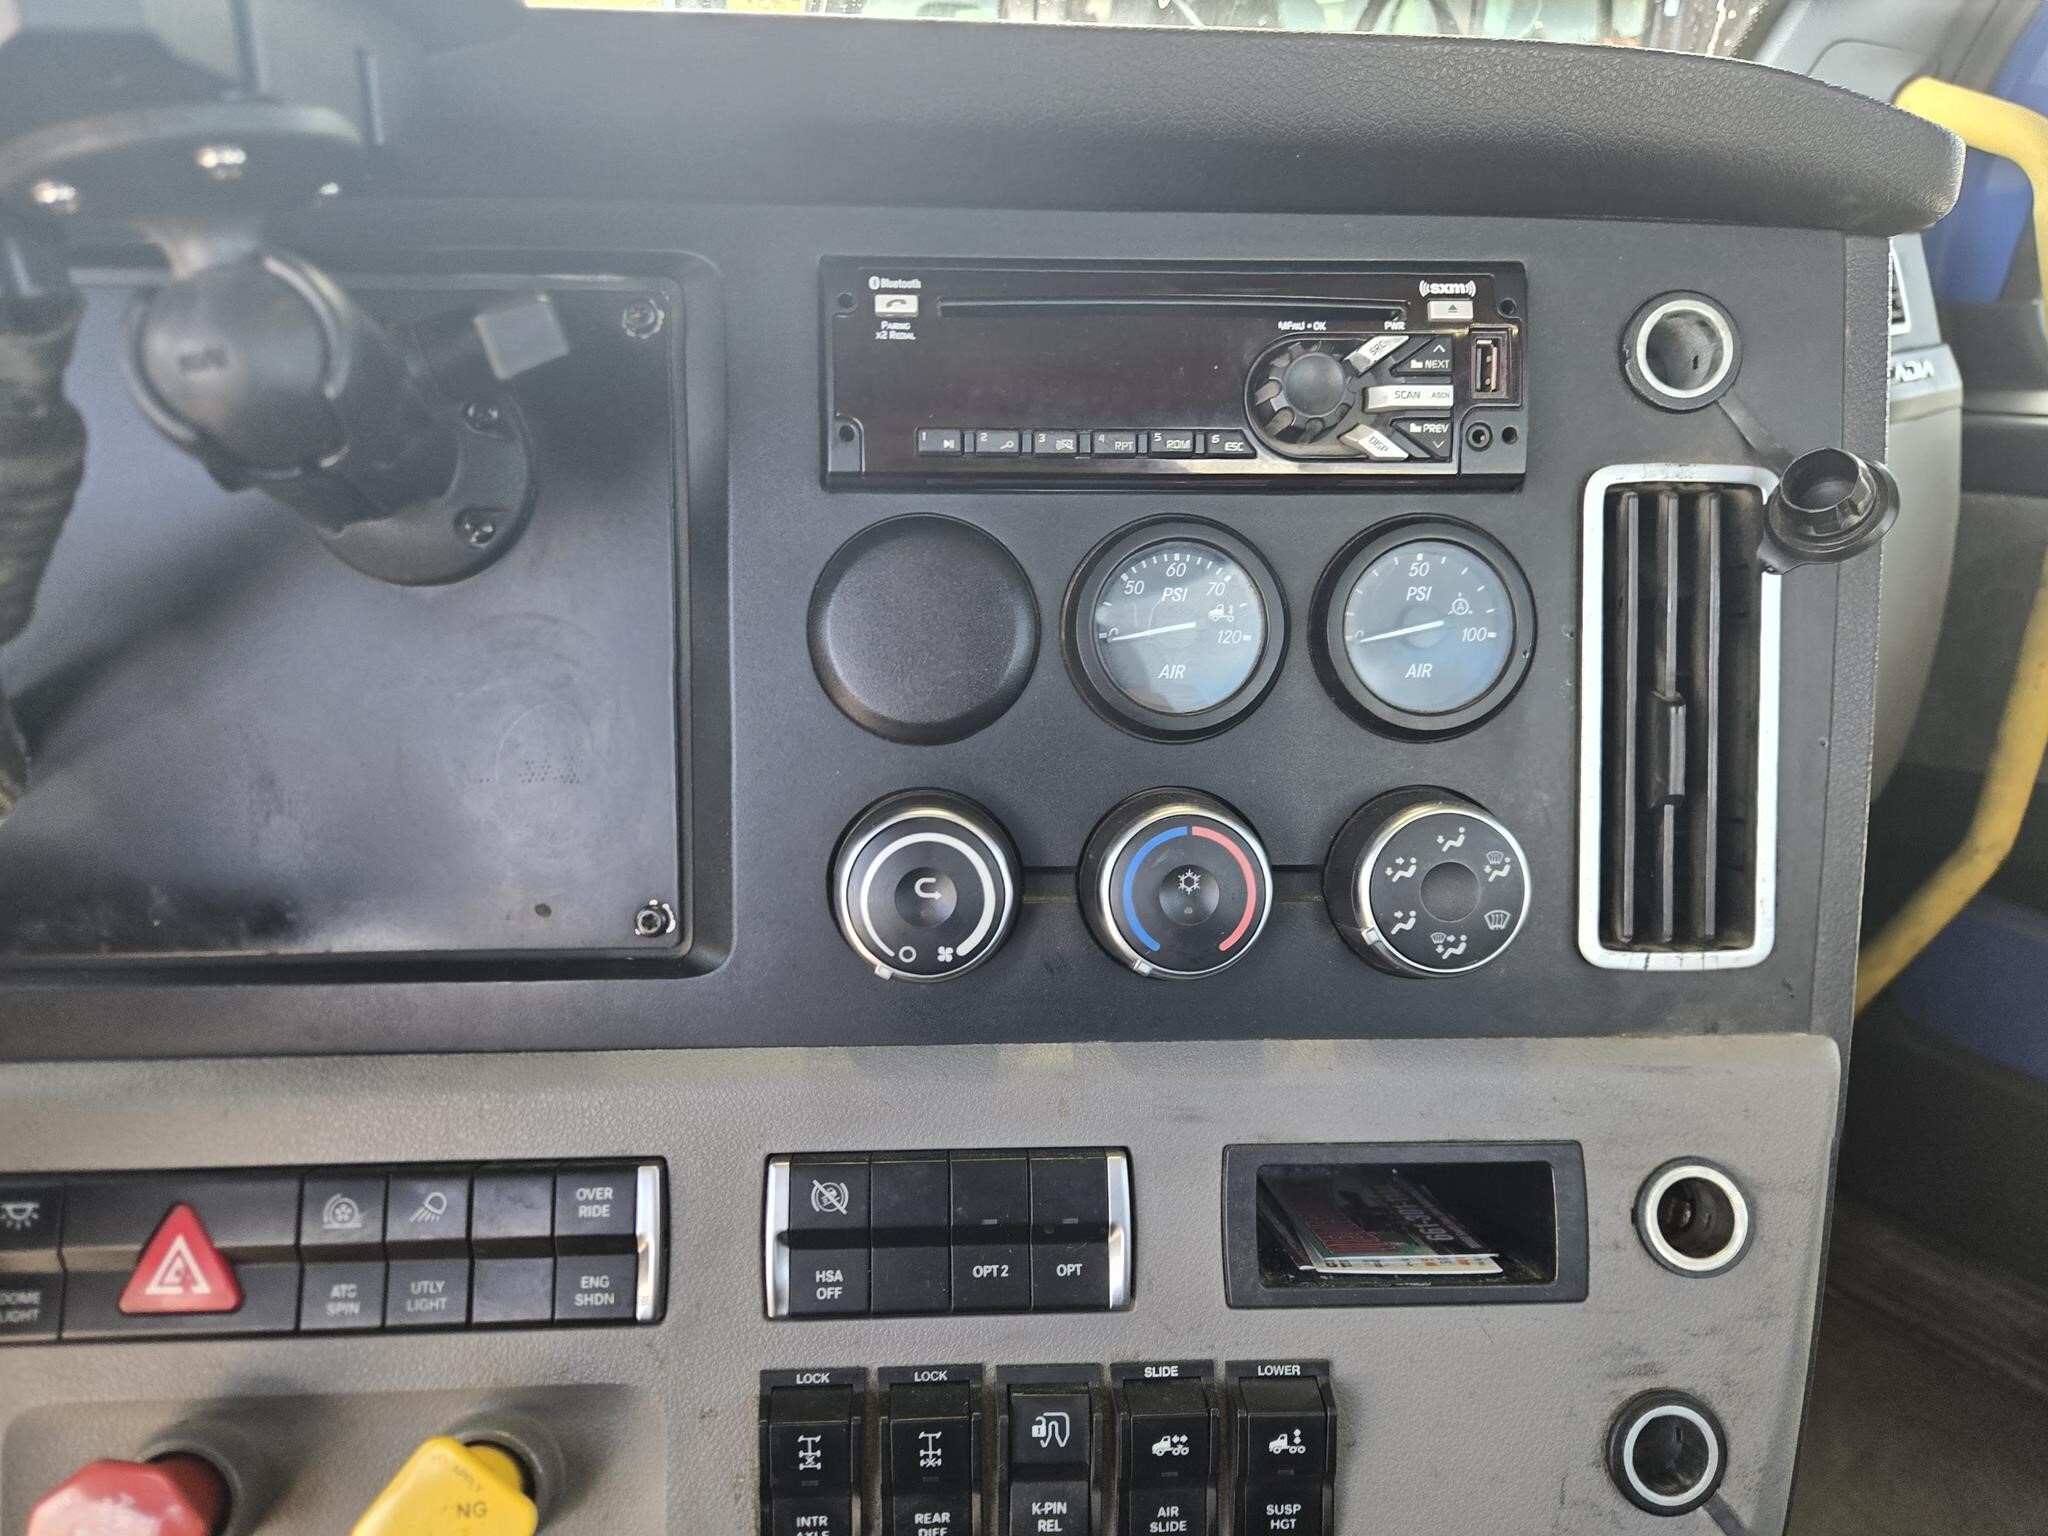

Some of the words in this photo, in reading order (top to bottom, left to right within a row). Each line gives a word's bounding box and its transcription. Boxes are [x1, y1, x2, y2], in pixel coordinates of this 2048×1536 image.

[881, 278, 922, 289] Bluetooth
[1313, 321, 1327, 331] OK
[1384, 321, 1405, 331] PWR
[1369, 340, 1388, 356] SRC
[1424, 360, 1450, 369] NEXT
[1394, 391, 1421, 400] SCAN
[1423, 423, 1449, 433] PREV
[921, 431, 927, 441] 1
[980, 432, 989, 442] 2
[1038, 433, 1046, 443] 3
[1098, 434, 1105, 443] 4
[1115, 441, 1133, 450] RPT
[1154, 432, 1162, 442] 5
[1211, 434, 1220, 444] 6
[1224, 442, 1244, 451] ESC
[1368, 435, 1389, 453] DISP
[1166, 562, 1187, 578] 60
[1409, 562, 1430, 577] 50
[1124, 580, 1145, 595] 50
[1161, 587, 1188, 602] PSI
[1206, 582, 1226, 596] 70
[1406, 586, 1433, 601] PSI
[1217, 630, 1242, 644] 120
[1461, 627, 1487, 642] 100
[1158, 664, 1186, 679] AIR
[1405, 663, 1433, 678] AIR
[576, 1186, 613, 1201] OVER
[578, 1204, 611, 1218] RIDE
[815, 1269, 844, 1283] HSA
[972, 1264, 999, 1279] OPT
[1000, 1265, 1009, 1278] 2
[1056, 1263, 1083, 1277] OPT
[410, 1280, 445, 1295] UTLY
[580, 1275, 610, 1290] ENG
[574, 1293, 615, 1307] SHDN
[816, 1286, 843, 1300] OFF
[326, 1301, 360, 1317] SPIN
[406, 1297, 448, 1312] LIGHT
[914, 1370, 948, 1382] LOCK
[1144, 1366, 1179, 1379] SLIDE
[1257, 1365, 1301, 1377] LOWER
[796, 1373, 830, 1385] LOCK
[1031, 1502, 1068, 1516] K-PIN
[1157, 1505, 1180, 1518] AIR
[1266, 1504, 1302, 1517] SUSP
[796, 1515, 829, 1528] INTR
[914, 1511, 951, 1525] REAR
[1270, 1518, 1297, 1531] HGT
[918, 1527, 949, 1536] DIFF
[1037, 1519, 1063, 1533] REL
[1149, 1520, 1188, 1534] SLIDE
